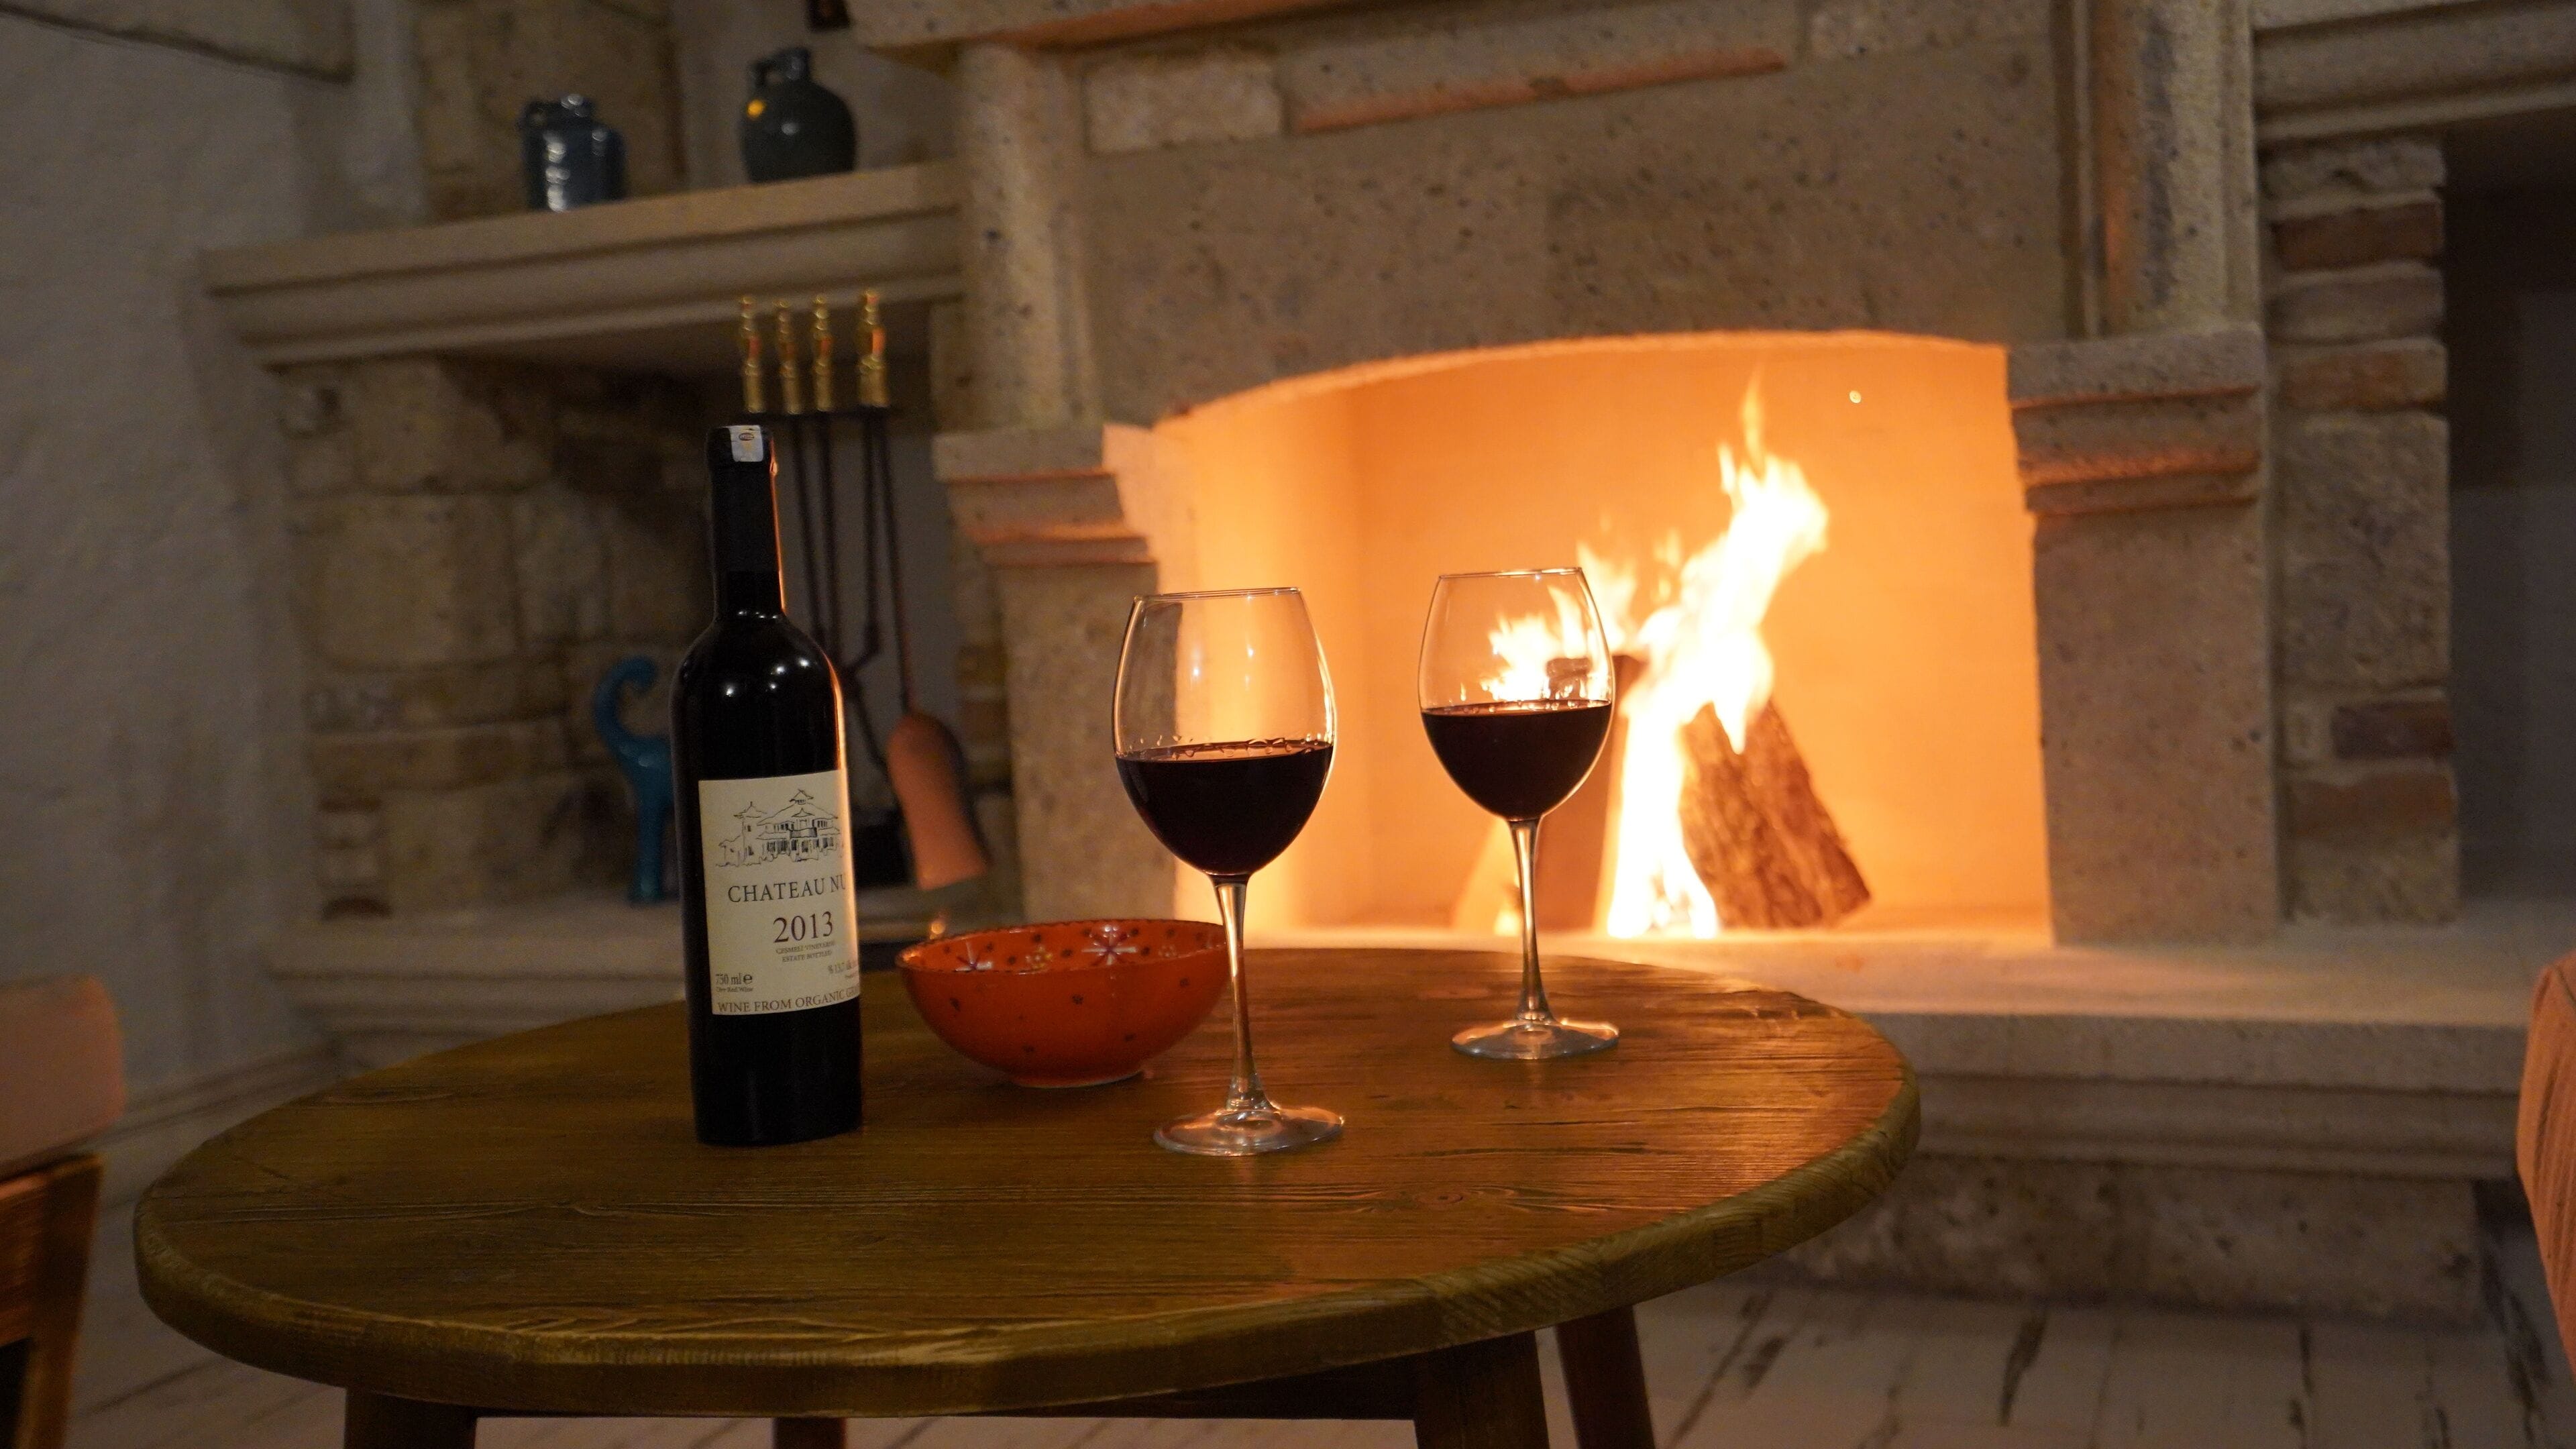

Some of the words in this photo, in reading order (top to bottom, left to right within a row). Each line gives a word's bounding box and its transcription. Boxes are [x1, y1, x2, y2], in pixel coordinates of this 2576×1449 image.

[728, 878, 825, 903] CHATEAU
[773, 911, 833, 943] 2013
[715, 973, 729, 985] 750
[718, 1002, 751, 1013] WINE
[755, 1000, 792, 1012] FROM
[795, 989, 846, 1008] ORGANIC
